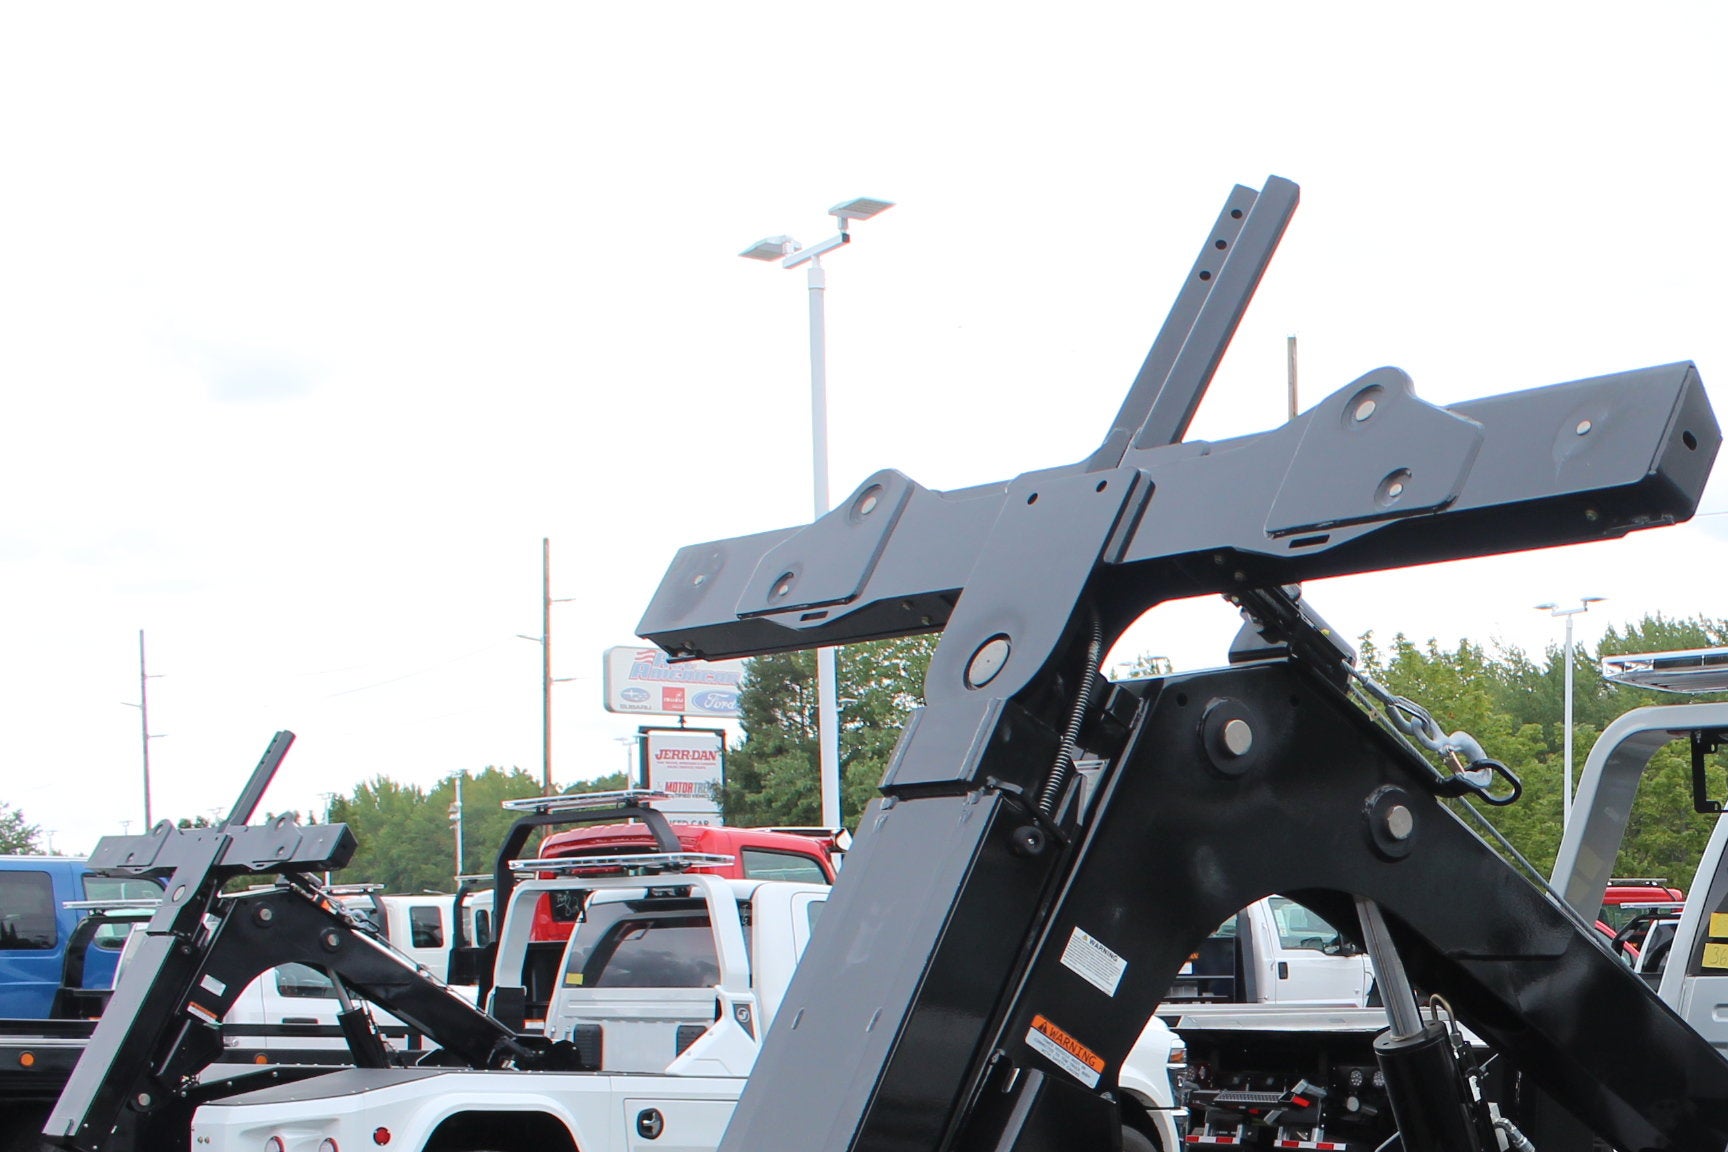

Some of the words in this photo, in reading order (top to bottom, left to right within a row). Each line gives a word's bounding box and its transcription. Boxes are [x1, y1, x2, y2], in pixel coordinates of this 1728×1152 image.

[704, 693, 736, 709] Ford
[1088, 937, 1118, 963] WARNING
[1048, 1025, 1098, 1068] WARNING
